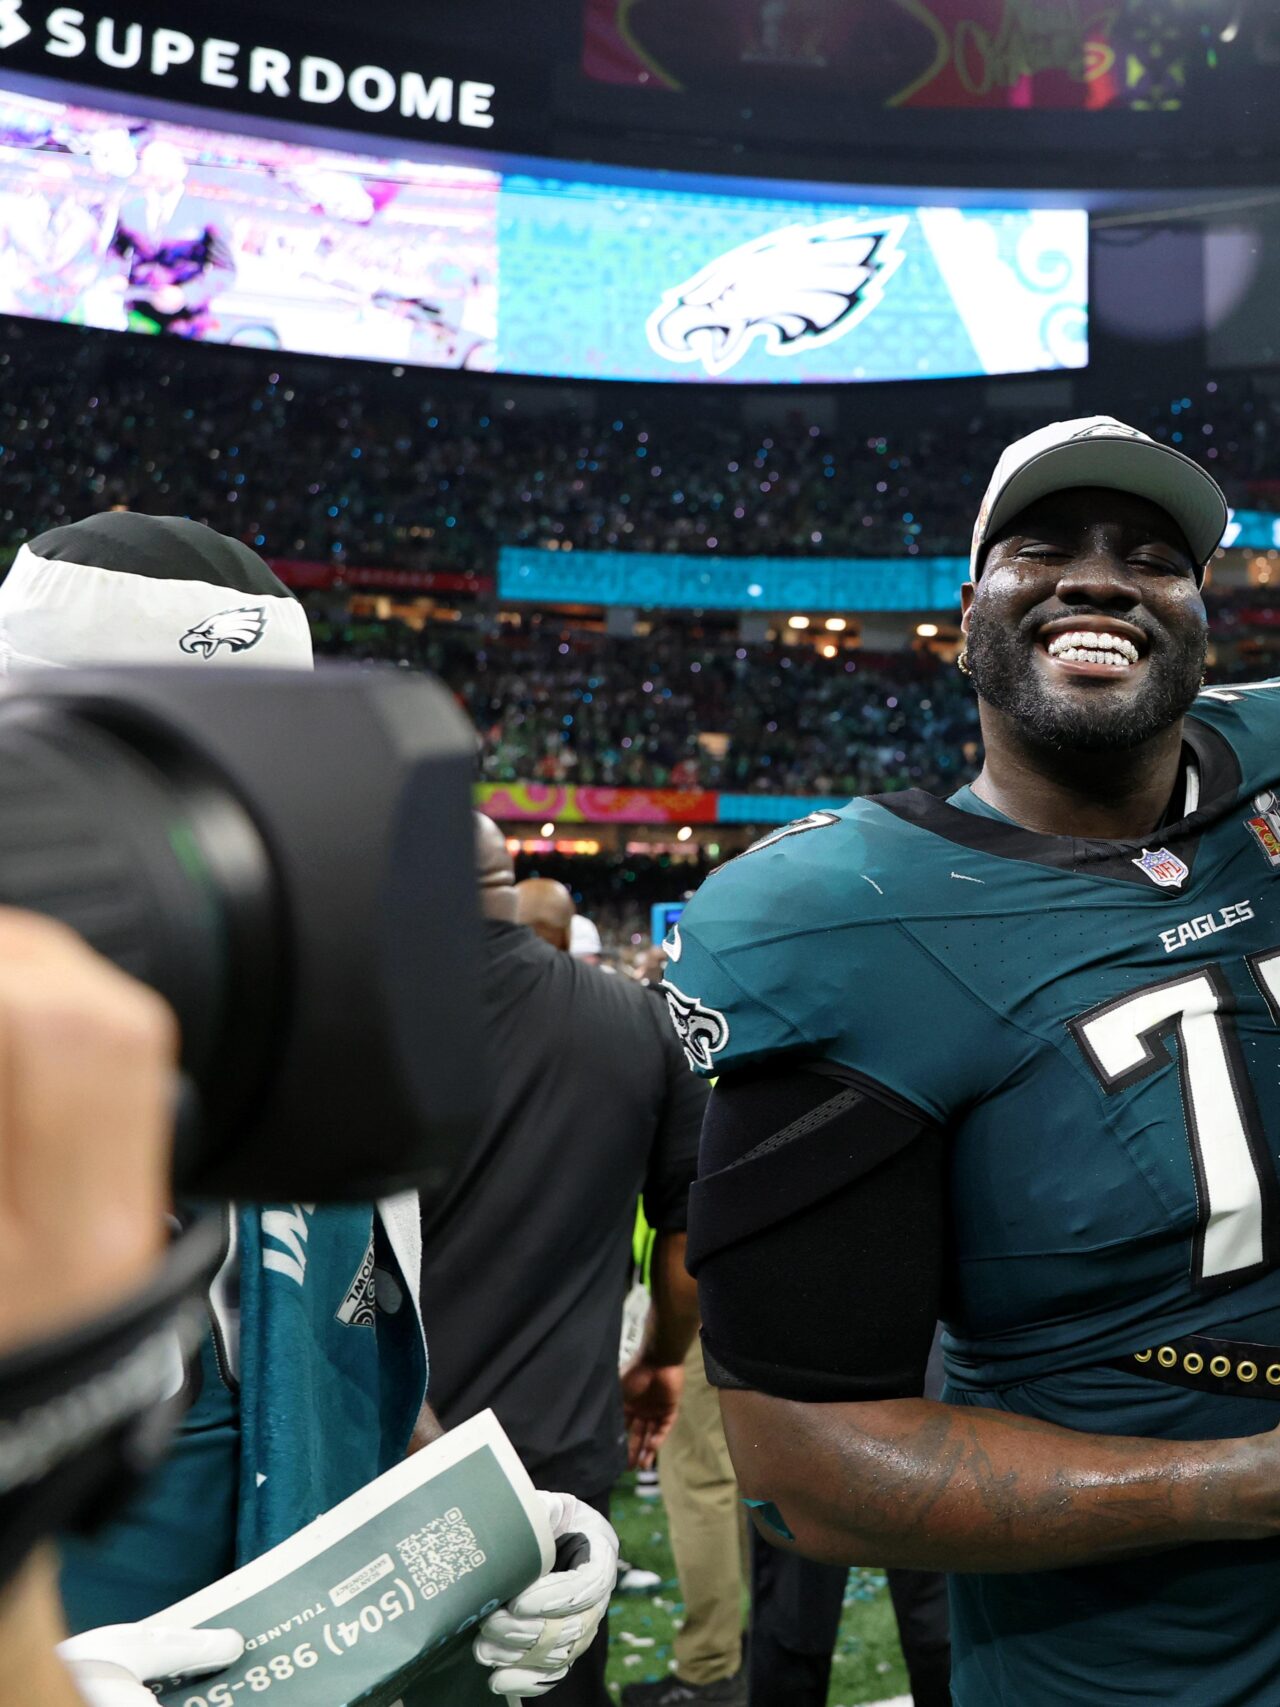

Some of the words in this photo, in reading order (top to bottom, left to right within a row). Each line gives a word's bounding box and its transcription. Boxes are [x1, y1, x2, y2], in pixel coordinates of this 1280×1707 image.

[45, 7, 496, 130] SUPERDOME
[1152, 860, 1181, 880] NFL
[1158, 900, 1255, 953] EAGLES
[323, 1577, 416, 1656] (504)
